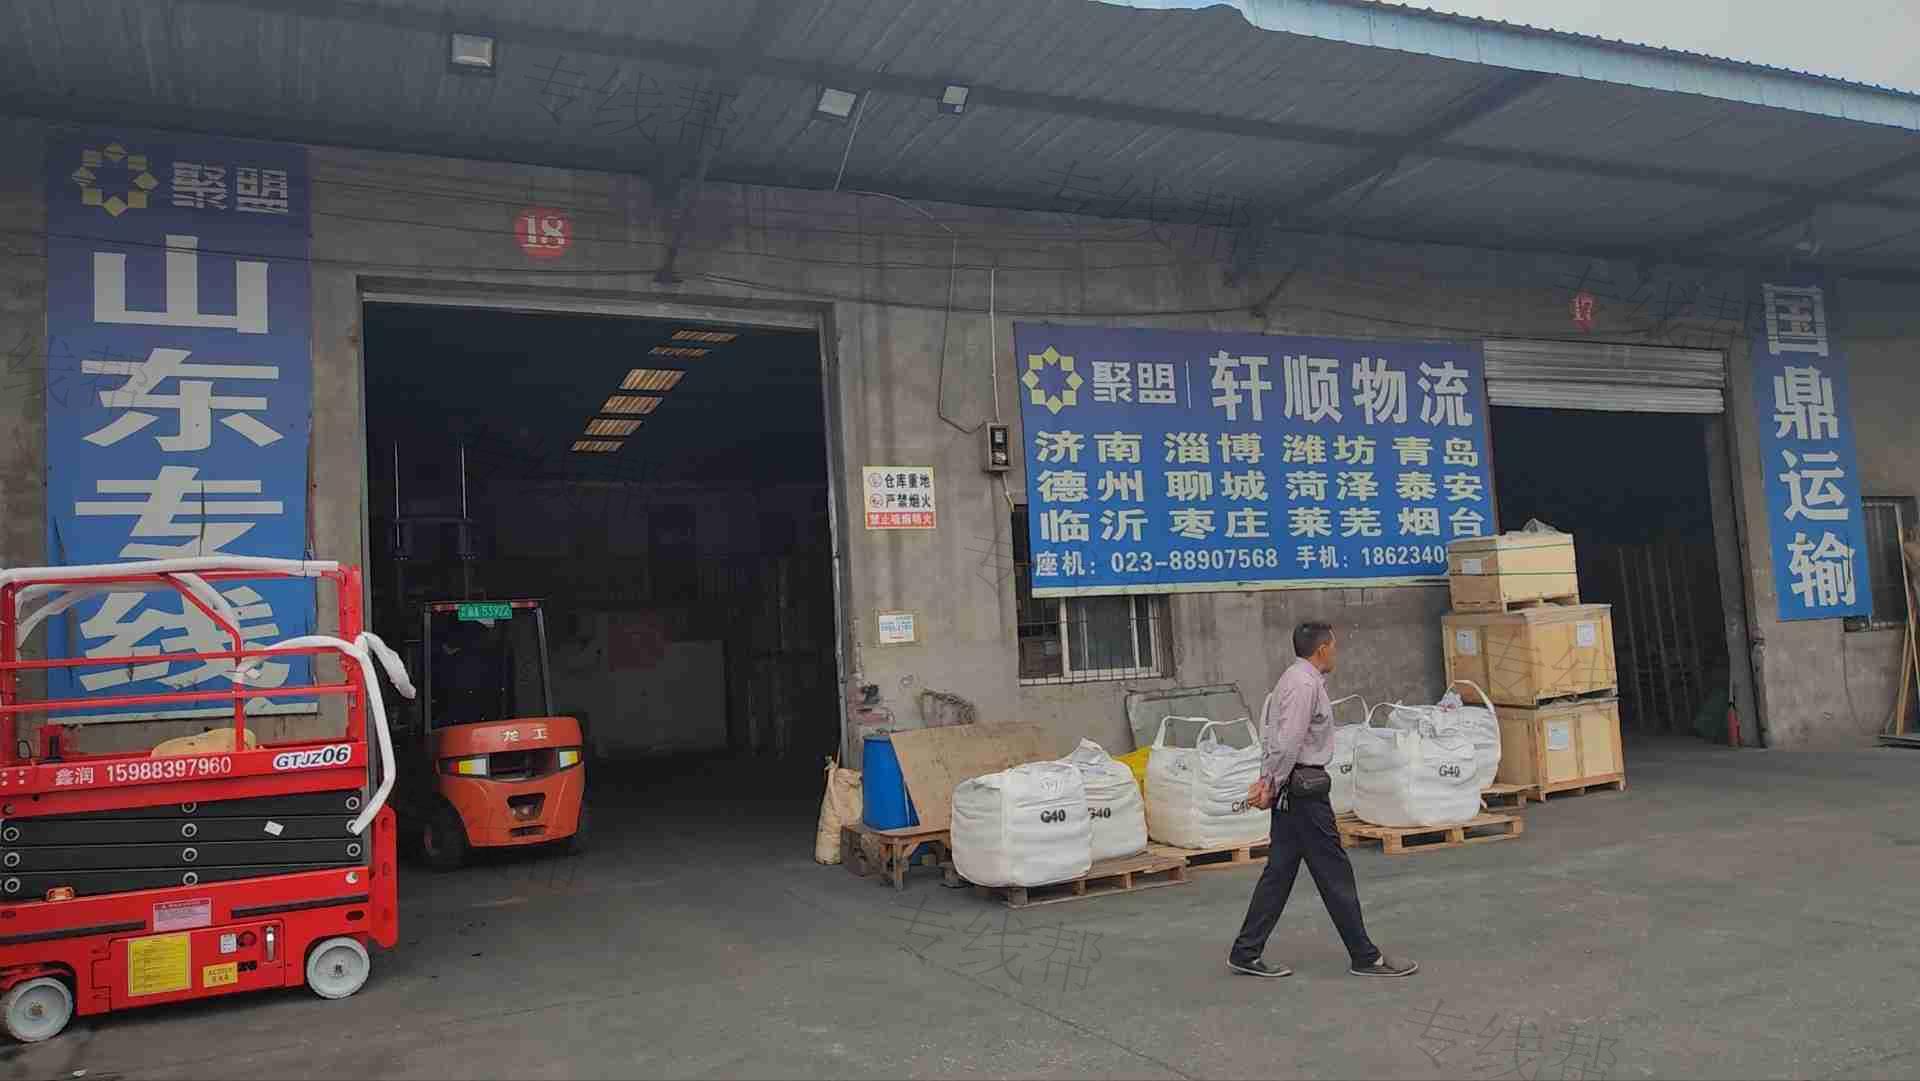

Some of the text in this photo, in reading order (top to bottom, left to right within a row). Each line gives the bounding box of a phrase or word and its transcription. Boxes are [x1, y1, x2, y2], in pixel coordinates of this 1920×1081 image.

[172, 161, 289, 212] 聚盟
[526, 215, 566, 249] 18
[1091, 350, 1472, 426] 聚盟 轩顺物流
[1034, 431, 1479, 467] 济南 淄博 潍坊 青岛
[1763, 283, 1856, 607] 国鼎运输
[884, 473, 930, 489] 仓库重地
[1037, 470, 1482, 502] 德州 聊城 菏泽 泰安
[885, 494, 932, 509] 严禁烟火
[1040, 506, 1485, 542] 临沂 枣庄 莱芜 烟台
[1111, 548, 1279, 574] 023-88907568
[1360, 545, 1449, 567] 1862340
[55, 745, 352, 787] 鑫润 15988397960 GTJZ06
[1438, 764, 1461, 778] G40
[1040, 808, 1067, 826] G40
